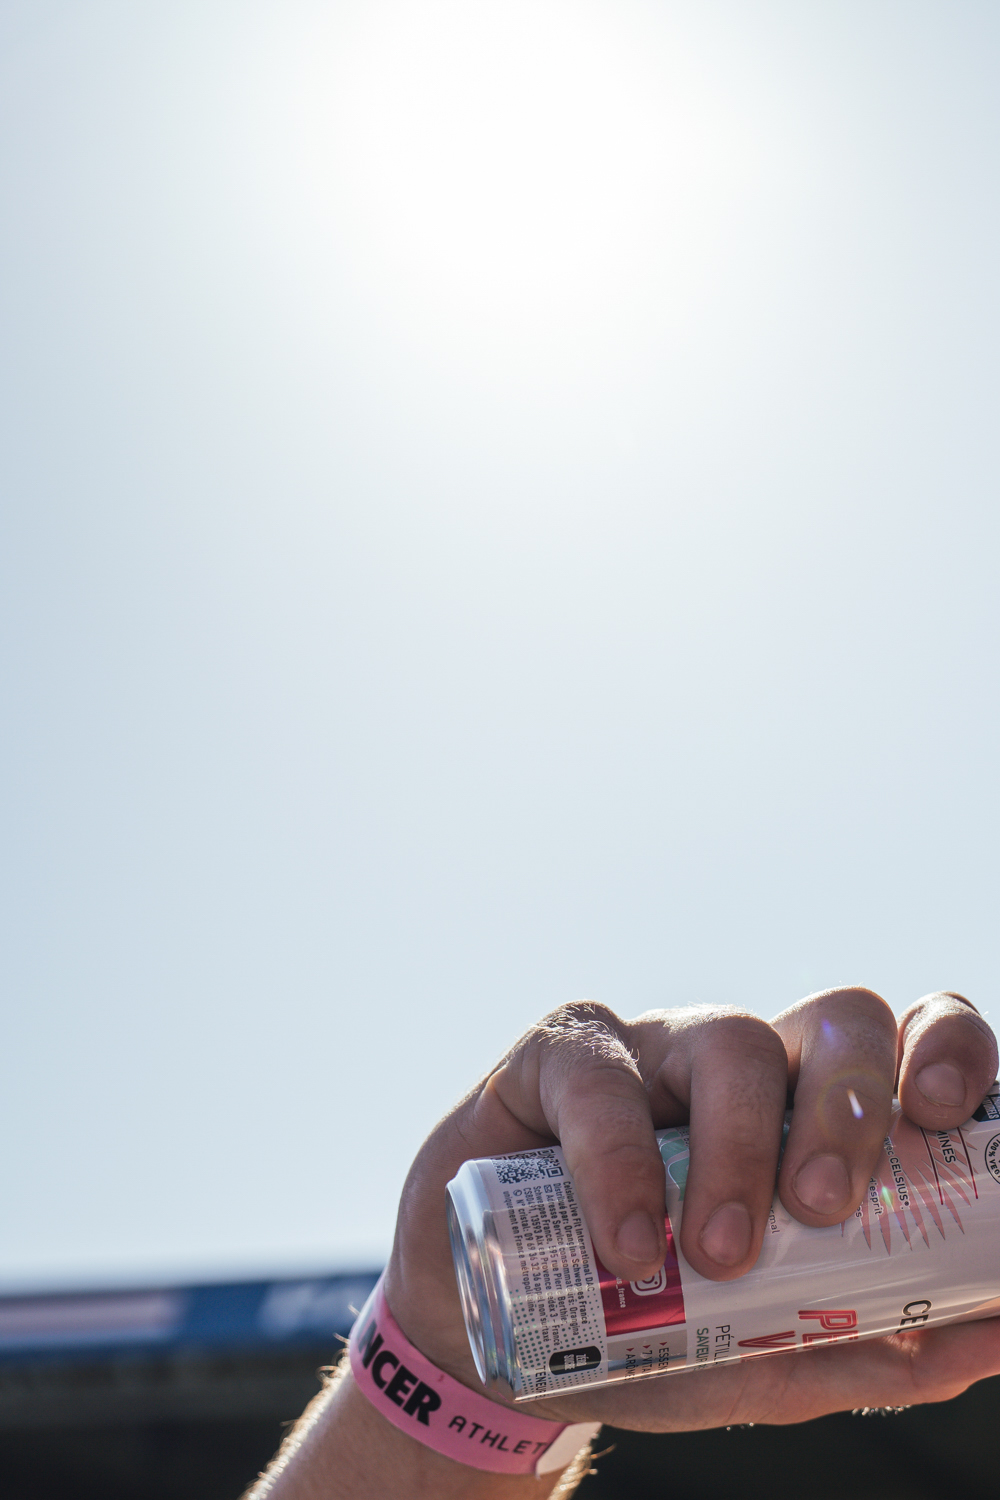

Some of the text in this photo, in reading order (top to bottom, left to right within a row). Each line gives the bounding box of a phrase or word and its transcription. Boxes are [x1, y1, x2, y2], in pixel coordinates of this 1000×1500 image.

[989, 1139, 1000, 1156] 100%
[503, 1190, 518, 1224] uniquement
[514, 1234, 526, 1258] France
[531, 1214, 542, 1233] 13593
[534, 1185, 548, 1218] Schweppes
[553, 1272, 564, 1295] Pierre
[536, 1234, 544, 1245] Aix
[553, 1219, 565, 1245] Service
[563, 1181, 595, 1291] Celsius Live Fit International DAC
[559, 1210, 570, 1224] par:
[572, 1258, 585, 1299] Schweppes
[540, 1257, 553, 1289] Provence
[899, 1299, 932, 1334] CEL
[357, 1320, 549, 1456] NCER ATHLET
